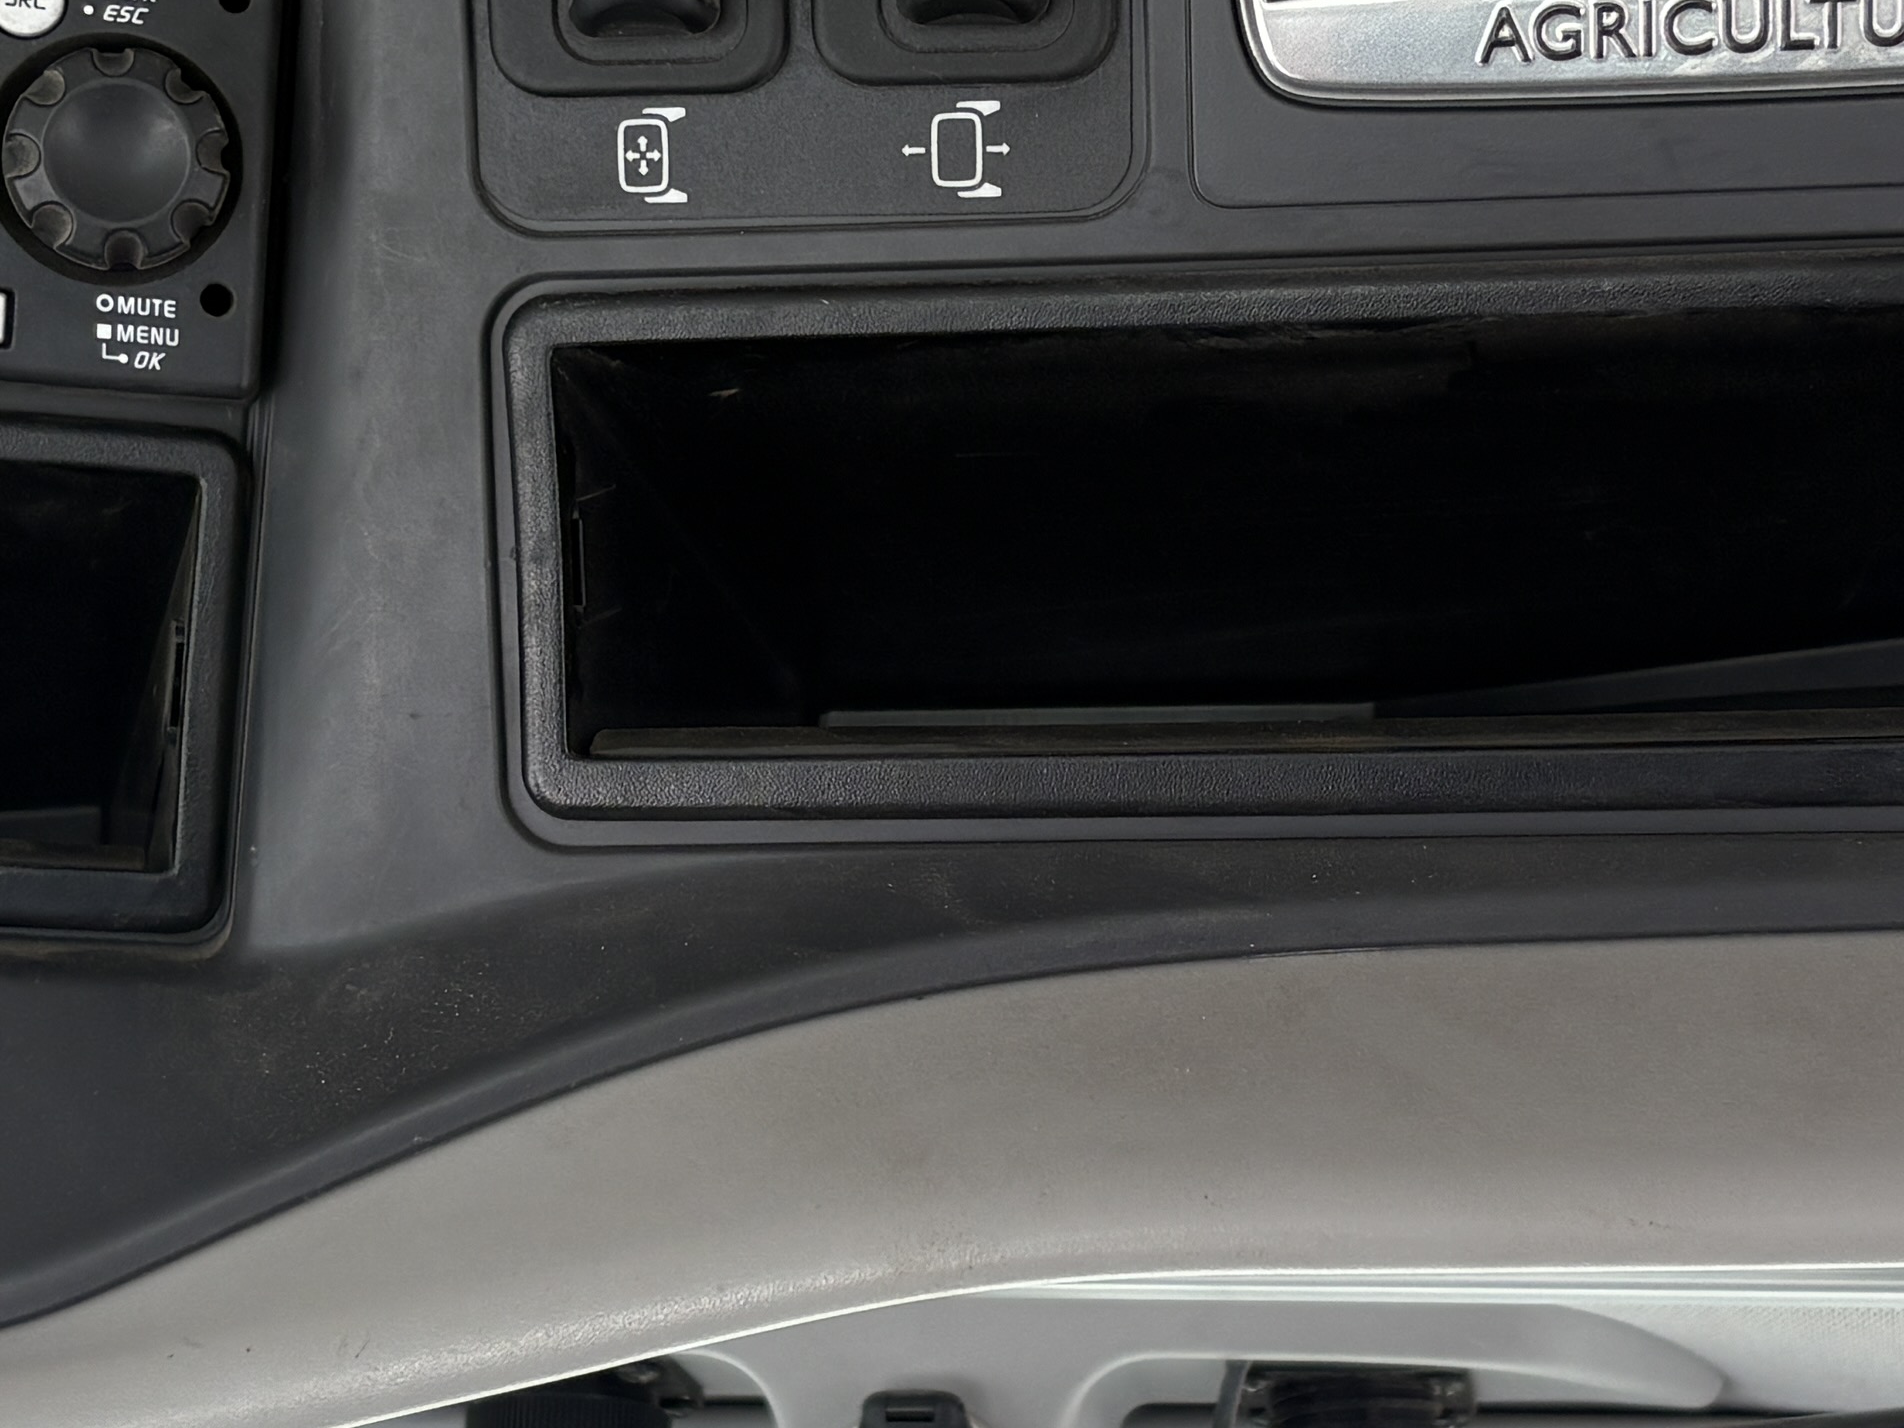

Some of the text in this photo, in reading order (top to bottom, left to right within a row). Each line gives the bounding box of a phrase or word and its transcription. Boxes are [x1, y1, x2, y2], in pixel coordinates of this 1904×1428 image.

[103, 5, 150, 25] ESC
[117, 295, 176, 318] MUTE
[117, 324, 179, 346] MENU
[134, 351, 166, 370] OK
